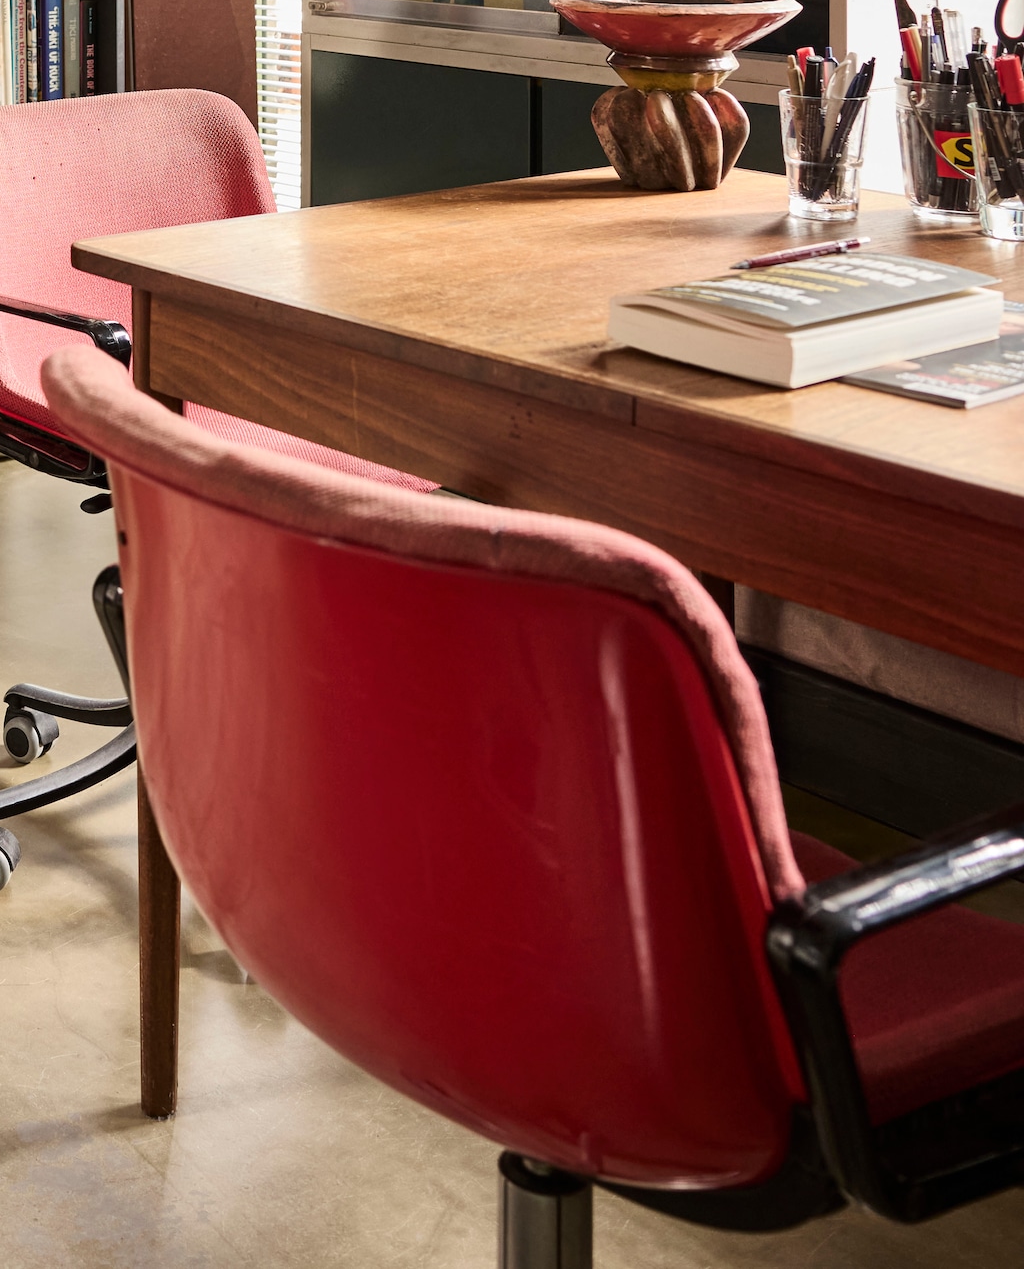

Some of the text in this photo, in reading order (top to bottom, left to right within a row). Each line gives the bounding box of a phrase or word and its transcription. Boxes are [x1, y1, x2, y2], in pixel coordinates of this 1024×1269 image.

[48, 7, 58, 29] THE
[86, 44, 94, 57] THE
[49, 51, 58, 64] OF
[87, 81, 94, 89] OF
